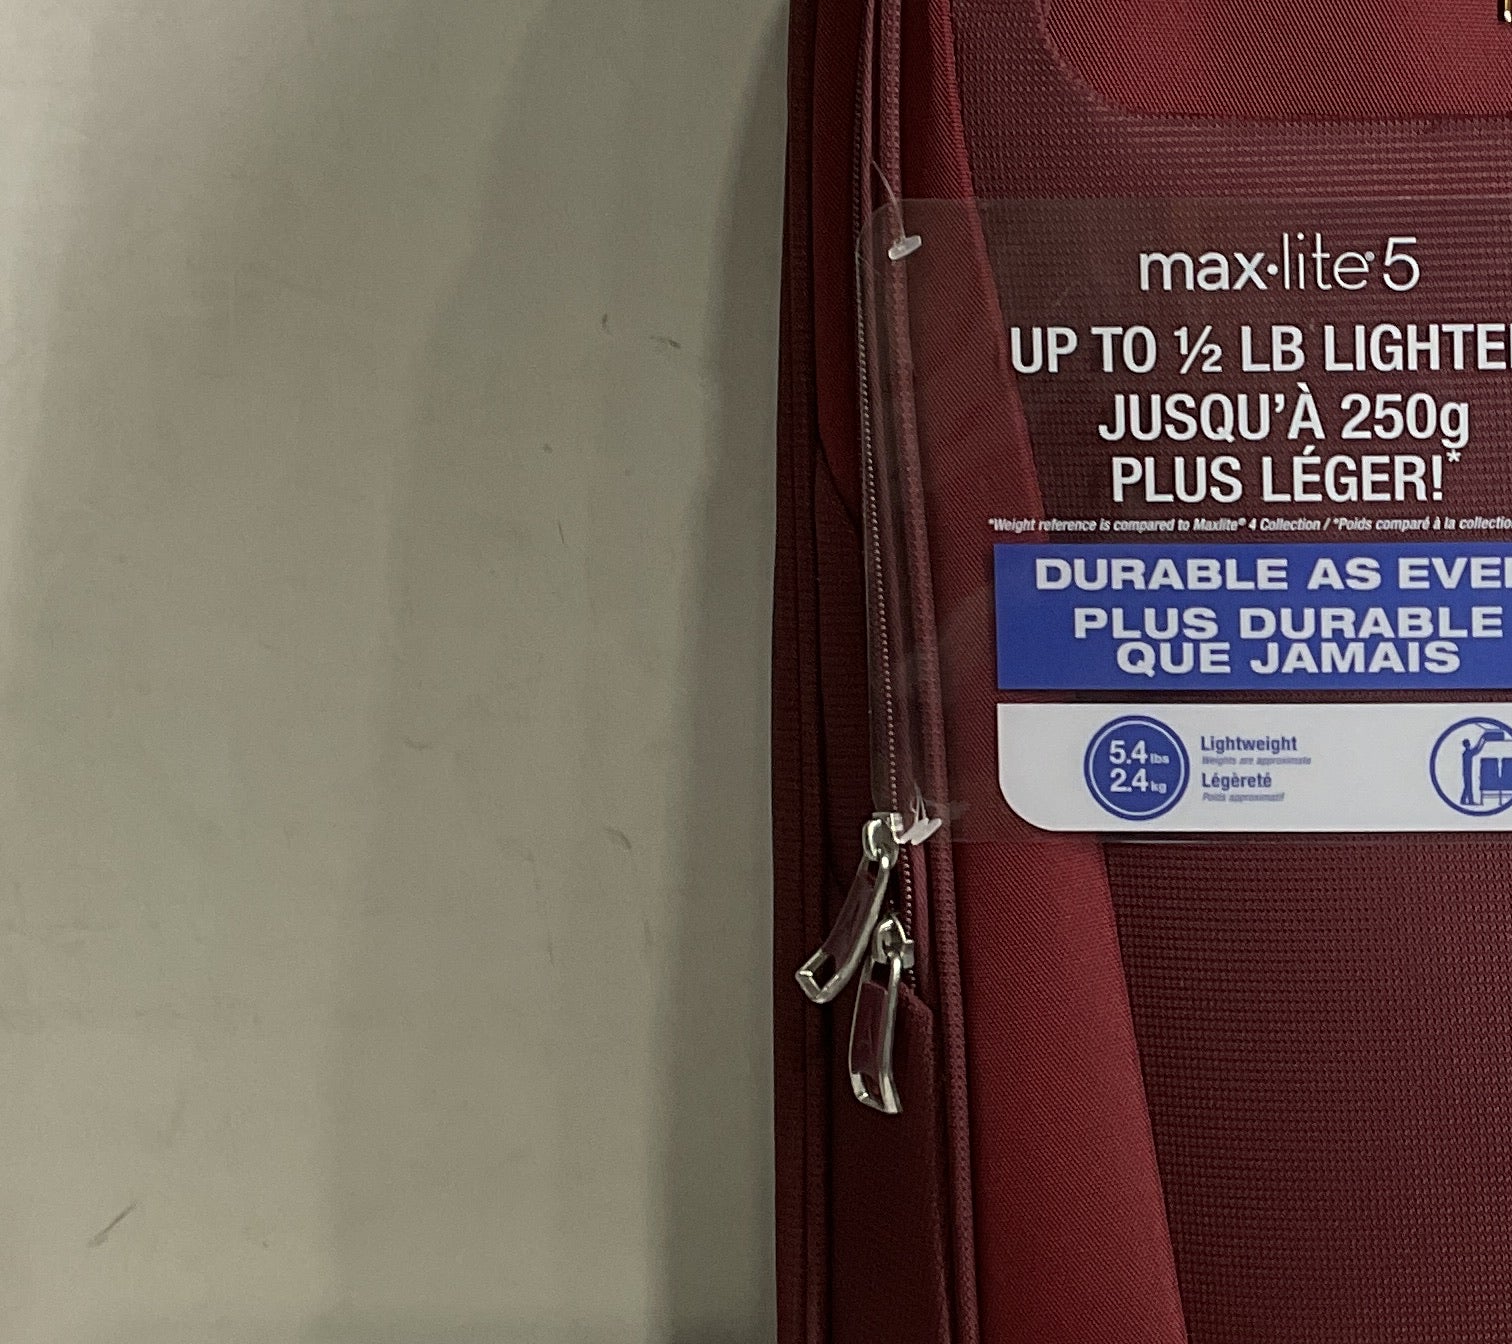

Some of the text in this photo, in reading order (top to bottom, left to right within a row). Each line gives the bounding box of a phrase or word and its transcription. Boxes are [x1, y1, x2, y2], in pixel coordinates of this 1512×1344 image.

[1010, 327, 1078, 374] UP
[1091, 326, 1157, 374] TO
[1241, 326, 1304, 372] LB
[1340, 393, 1469, 449] 250g
[1112, 455, 1243, 503] PLUS
[1038, 519, 1097, 531] reference
[1099, 519, 1110, 530] is
[1113, 518, 1174, 534] compared
[1178, 518, 1190, 530] to
[1248, 518, 1256, 530] 4
[1260, 517, 1320, 530] Collection
[1376, 516, 1430, 532] comparé
[1432, 517, 1440, 530] à
[1444, 518, 1456, 530] la
[1035, 558, 1289, 591] DURABLE
[1307, 557, 1381, 591] AS
[1075, 606, 1503, 640] PLUS DURABLE
[1116, 641, 1461, 677] QUE JAMAIS
[1110, 740, 1148, 765] 5.4
[1201, 735, 1297, 754] Lightweight
[1110, 768, 1167, 794] 2.4 kg
[1202, 772, 1272, 790] Légèreté
